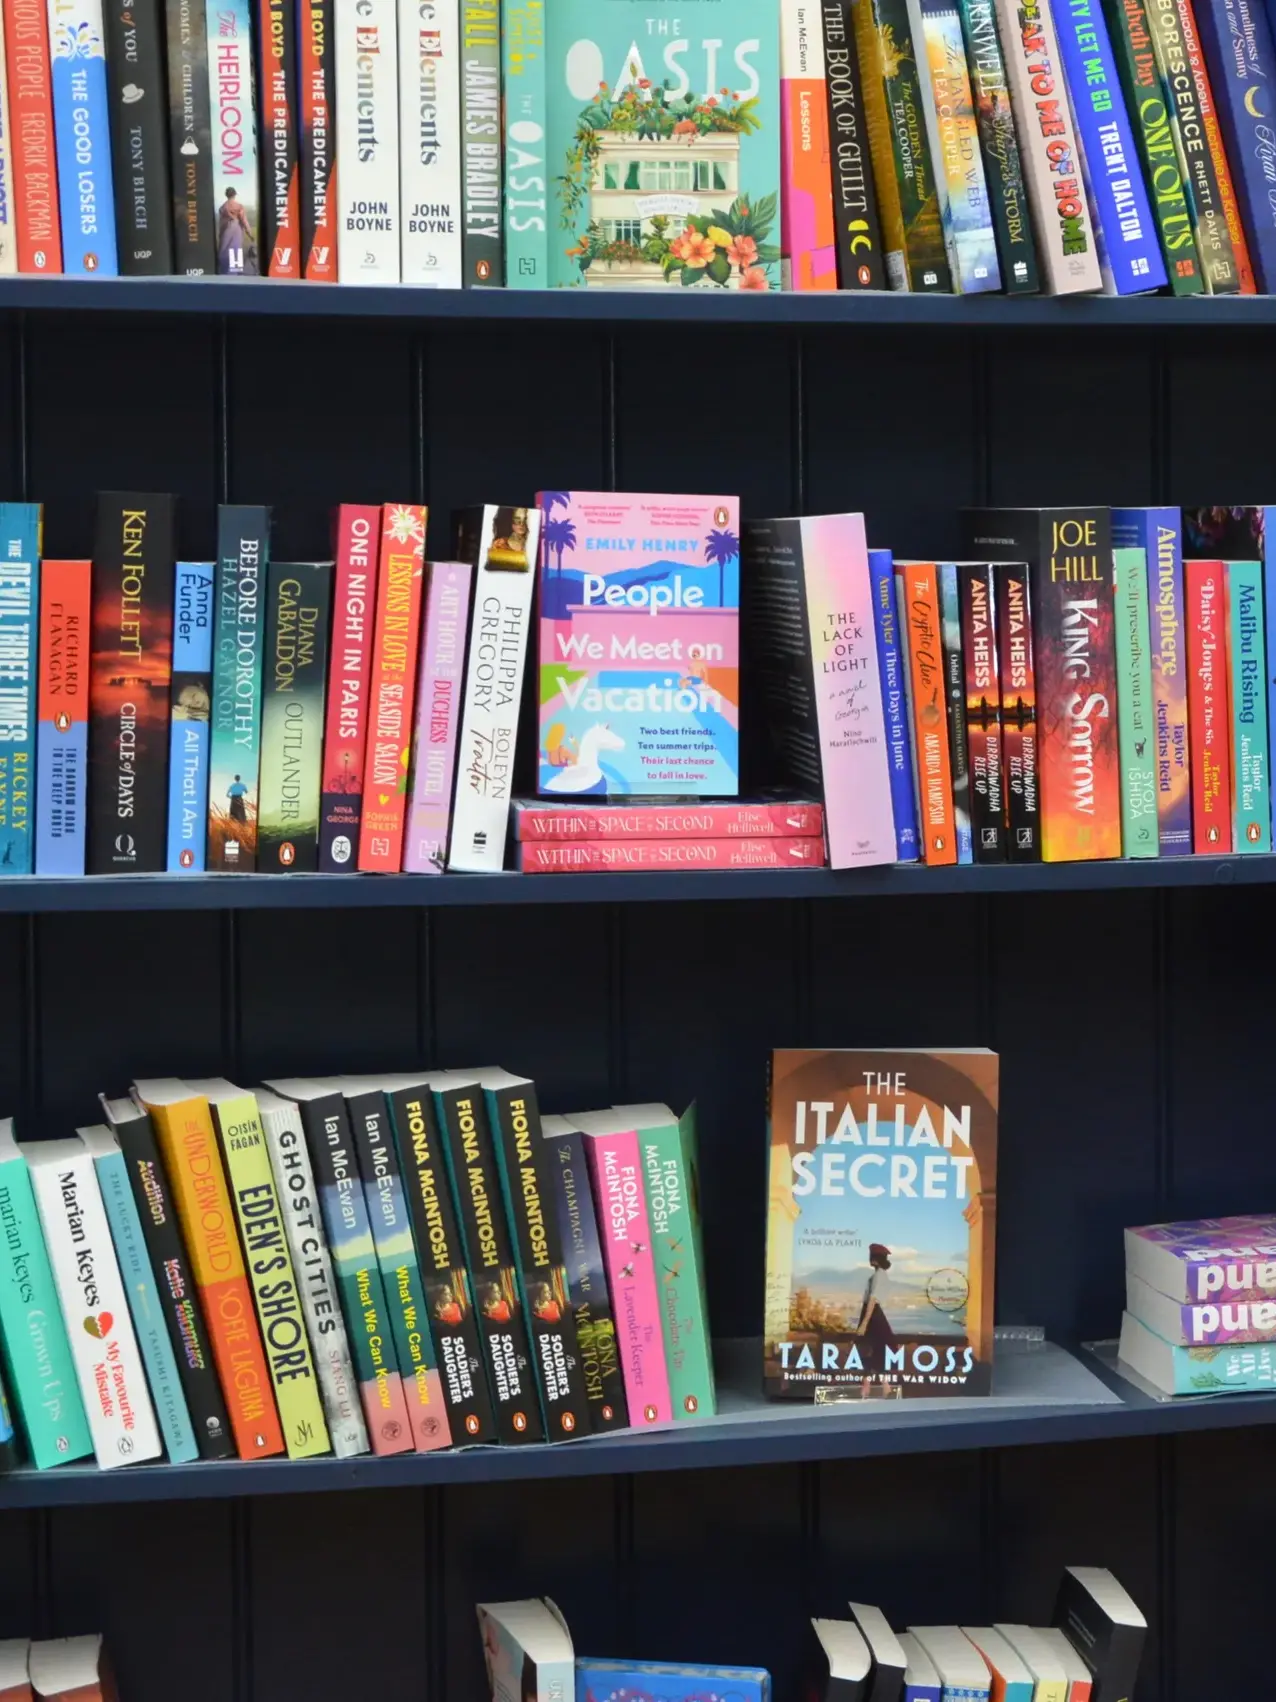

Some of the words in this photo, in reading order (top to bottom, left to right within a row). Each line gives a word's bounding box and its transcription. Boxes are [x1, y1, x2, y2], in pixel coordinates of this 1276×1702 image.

[270, 10, 284, 58] BOYD
[311, 10, 324, 56] BOYD
[646, 18, 682, 36] THE
[824, 3, 842, 43] THE
[1074, 22, 1099, 54] LET
[16, 46, 45, 99] PEOPLE
[71, 69, 88, 101] THE
[273, 71, 285, 102] THE
[312, 69, 325, 101] THE
[566, 38, 761, 104] OASIS
[827, 48, 855, 108] BOOK
[1081, 57, 1108, 86] ME
[800, 91, 812, 152] Lessons
[836, 113, 855, 138] OF
[1090, 91, 1113, 113] GO
[20, 112, 49, 167] FREDRIK
[73, 107, 92, 165] GOOD
[1097, 121, 1128, 176] TRENT
[274, 106, 288, 228] PREDICAMENT
[312, 105, 327, 228] PREDICAMENT
[508, 120, 546, 233] OASIS
[837, 142, 868, 212] GUILT
[24, 172, 52, 242] BACKMAN
[78, 171, 97, 236] LOSERS
[346, 218, 392, 231] BOYNE
[350, 202, 388, 215] JOHN
[409, 220, 454, 234] BOYNE
[412, 203, 450, 217] JOHN
[1111, 178, 1143, 242] DALTON
[1194, 160, 1212, 206] RHETT
[1204, 209, 1222, 250] DAVIS
[134, 250, 152, 259] UQP
[186, 268, 204, 277] UQP
[122, 510, 147, 557] KEN
[351, 519, 369, 567] ONE
[586, 538, 636, 551] EMILY
[643, 539, 698, 552] HENRY
[1052, 520, 1096, 550] JOE
[237, 538, 258, 624] BEFORE
[584, 574, 704, 616] People
[1051, 555, 1103, 583] HILL
[120, 564, 145, 662] FOLLETT
[180, 573, 197, 644] Funder
[197, 576, 212, 628] Anna
[346, 573, 366, 642] NIGHT
[828, 613, 856, 624] THE
[970, 579, 988, 632] ANITA
[1007, 579, 1024, 632] ANITA
[1155, 526, 1178, 677] Atmosphere
[1239, 584, 1259, 654] Malibu
[275, 580, 301, 692] GABALDON
[297, 607, 318, 667] DIANA
[343, 648, 361, 672] IN
[473, 597, 500, 712] GREGORY
[496, 607, 522, 707] PHILIPPA
[557, 633, 604, 659] We
[611, 634, 682, 660] Meet
[688, 643, 722, 660] on
[823, 628, 862, 641] LACK
[835, 645, 854, 656] OF
[823, 659, 868, 673] LIGHT
[974, 637, 990, 688] HEISS
[1011, 637, 1026, 688] HEISS
[235, 631, 257, 749] DOROTHY
[339, 680, 359, 738] PARIS
[556, 676, 721, 713] Vacation
[1240, 659, 1259, 725] Rising
[638, 741, 657, 751] Ten
[658, 742, 692, 751] summer
[694, 742, 717, 752] trips.
[640, 727, 661, 736] Two
[662, 727, 679, 736] best
[681, 727, 716, 737] friends.
[1172, 722, 1186, 768] Taylor
[281, 702, 304, 822] OUTLANDER
[641, 756, 663, 766] Their
[665, 757, 681, 766] last
[683, 757, 714, 766] chance
[647, 772, 657, 780] to
[658, 771, 673, 780] fall
[674, 772, 683, 780] in
[685, 772, 707, 780] love.
[738, 812, 759, 822] Elise
[1129, 768, 1144, 820] ISHIDA
[728, 821, 774, 834] Helliwell
[863, 1072, 906, 1096] THE
[230, 1134, 261, 1151] FAGAN
[324, 1116, 340, 1146] Ian
[365, 1113, 380, 1144] Ian
[510, 1100, 533, 1163] FIONA
[795, 1101, 971, 1148] ITALIAN
[331, 1150, 356, 1229] McEwan
[371, 1148, 397, 1227] McEwan
[406, 1101, 430, 1165] FIONA
[419, 1169, 450, 1270] McINTOSH
[456, 1099, 480, 1163] FIONA
[468, 1167, 498, 1268] McINTOSH
[603, 1151, 628, 1242] McINTOSH
[621, 1166, 640, 1222] FIONA
[645, 1145, 669, 1234] McINTOSH
[662, 1160, 681, 1214] FIONA
[791, 1152, 973, 1199] SECRET
[188, 1131, 233, 1274] UNDERWORLD
[519, 1168, 549, 1268] McINTOSH
[57, 1170, 85, 1244] Marian
[76, 1248, 100, 1308] Keyes
[238, 1184, 288, 1276] EDEN'S
[279, 1131, 314, 1237] GHOST
[301, 1237, 335, 1336] CITIES
[258, 1279, 311, 1385] SHORE
[779, 1342, 864, 1370] TARA
[884, 1344, 973, 1373] MOSS
[92, 1362, 113, 1418] Mistake
[441, 1337, 462, 1404] DAUGHTER
[489, 1334, 509, 1402] DAUGHTER
[539, 1334, 558, 1402] DAUGHTER
[784, 1373, 832, 1382] Bestselling
[867, 1374, 876, 1382] of
[879, 1374, 897, 1382] THE
[903, 1375, 924, 1383] WAR
[929, 1376, 967, 1384] WIDOW
